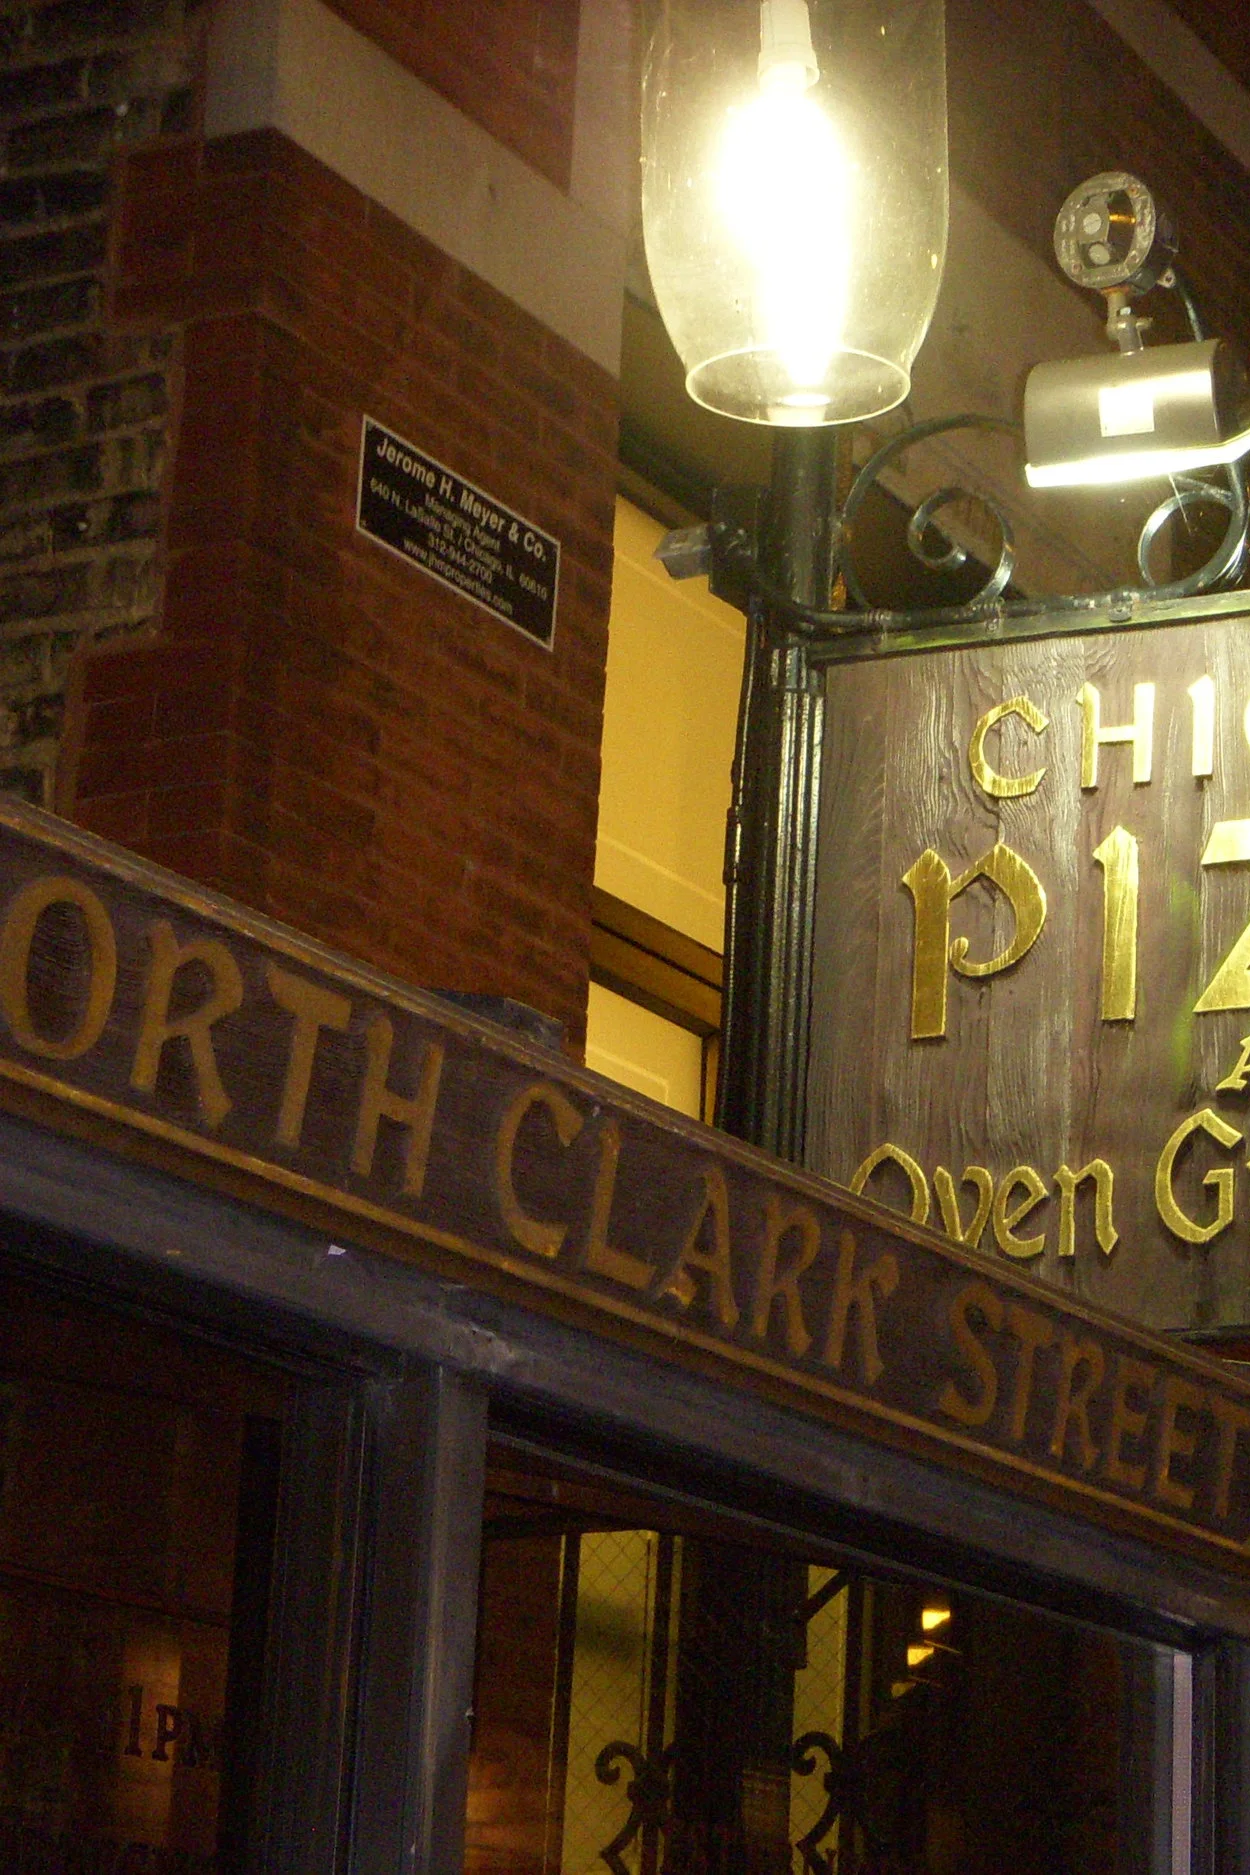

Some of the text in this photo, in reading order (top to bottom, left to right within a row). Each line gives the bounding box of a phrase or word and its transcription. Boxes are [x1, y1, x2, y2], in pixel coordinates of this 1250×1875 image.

[376, 437, 547, 563] Jerome H. Meyer & Co.
[495, 1081, 900, 1387] CLARK
[850, 1142, 1119, 1259] Oven
